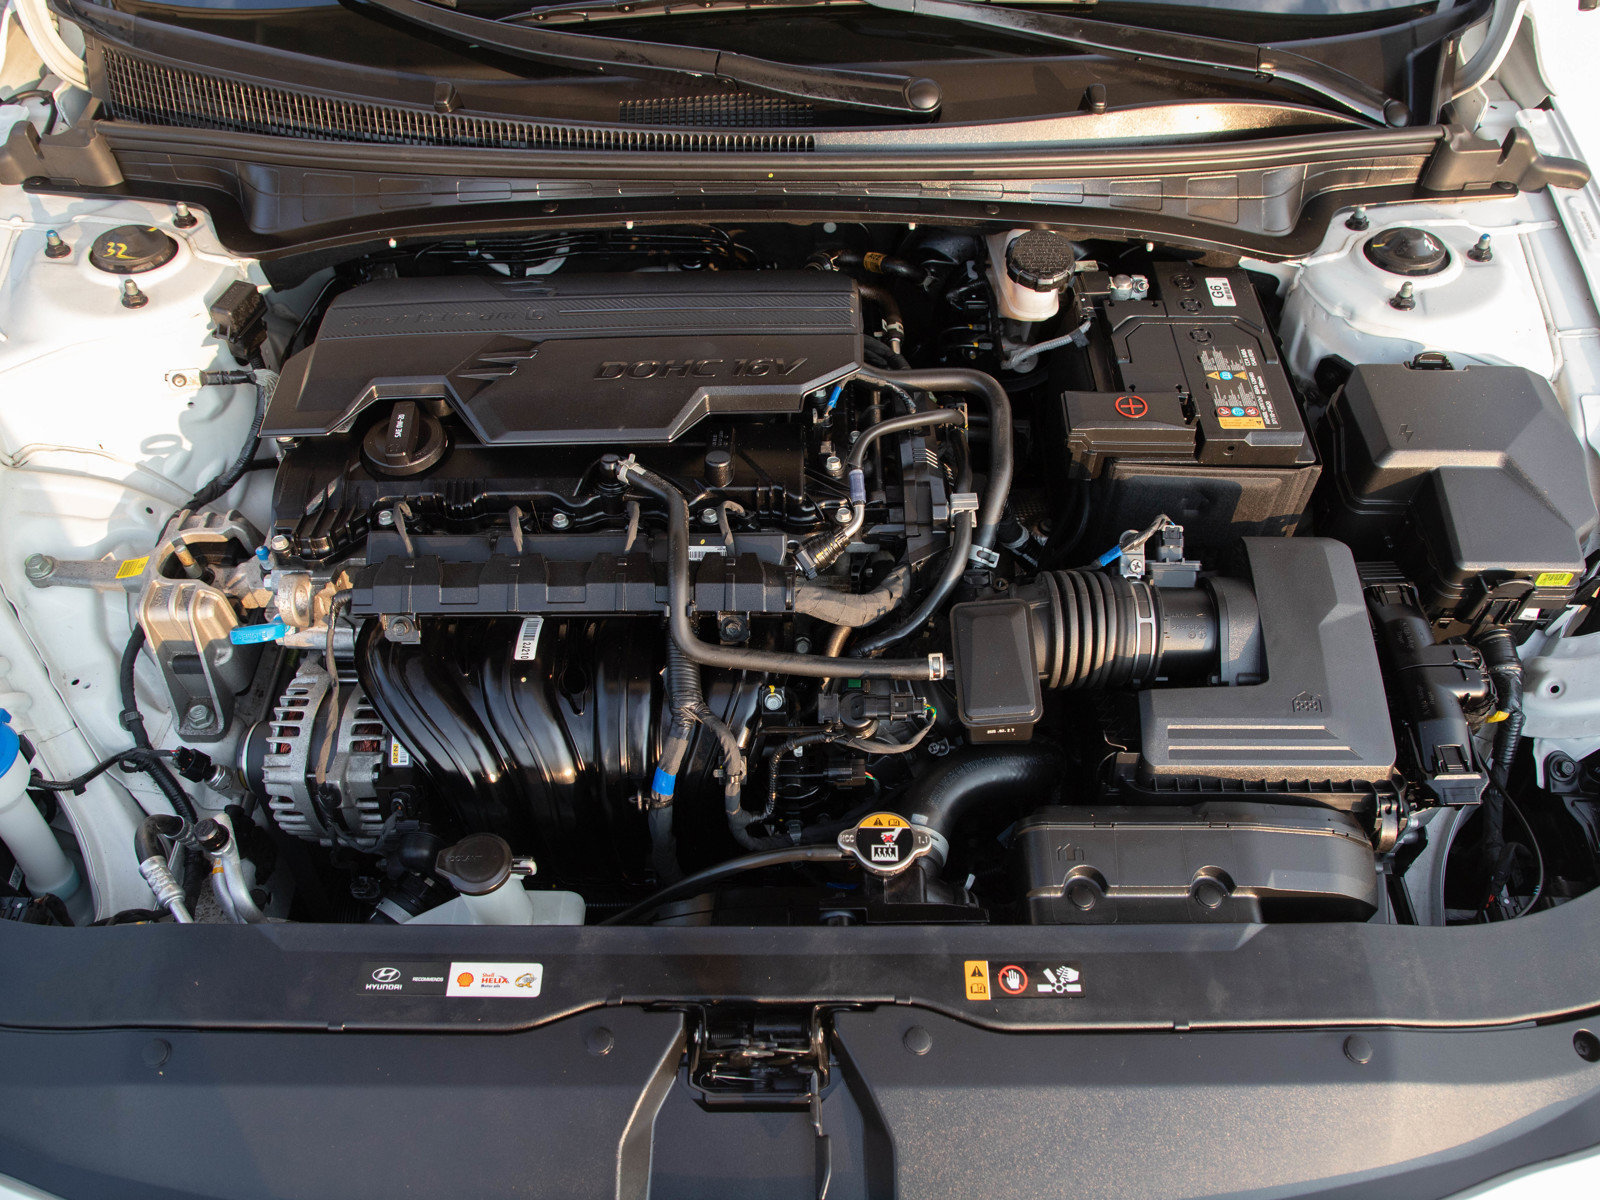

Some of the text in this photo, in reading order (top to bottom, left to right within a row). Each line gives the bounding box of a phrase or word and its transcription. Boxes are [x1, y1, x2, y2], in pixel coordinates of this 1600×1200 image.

[103, 241, 136, 259] 32
[1211, 285, 1225, 299] G6
[594, 357, 808, 380] DOHC 16V
[394, 428, 403, 438] SAE
[520, 642, 531, 660] 2J210
[365, 983, 403, 991] HYUNDAI
[481, 976, 510, 984] HELIX
